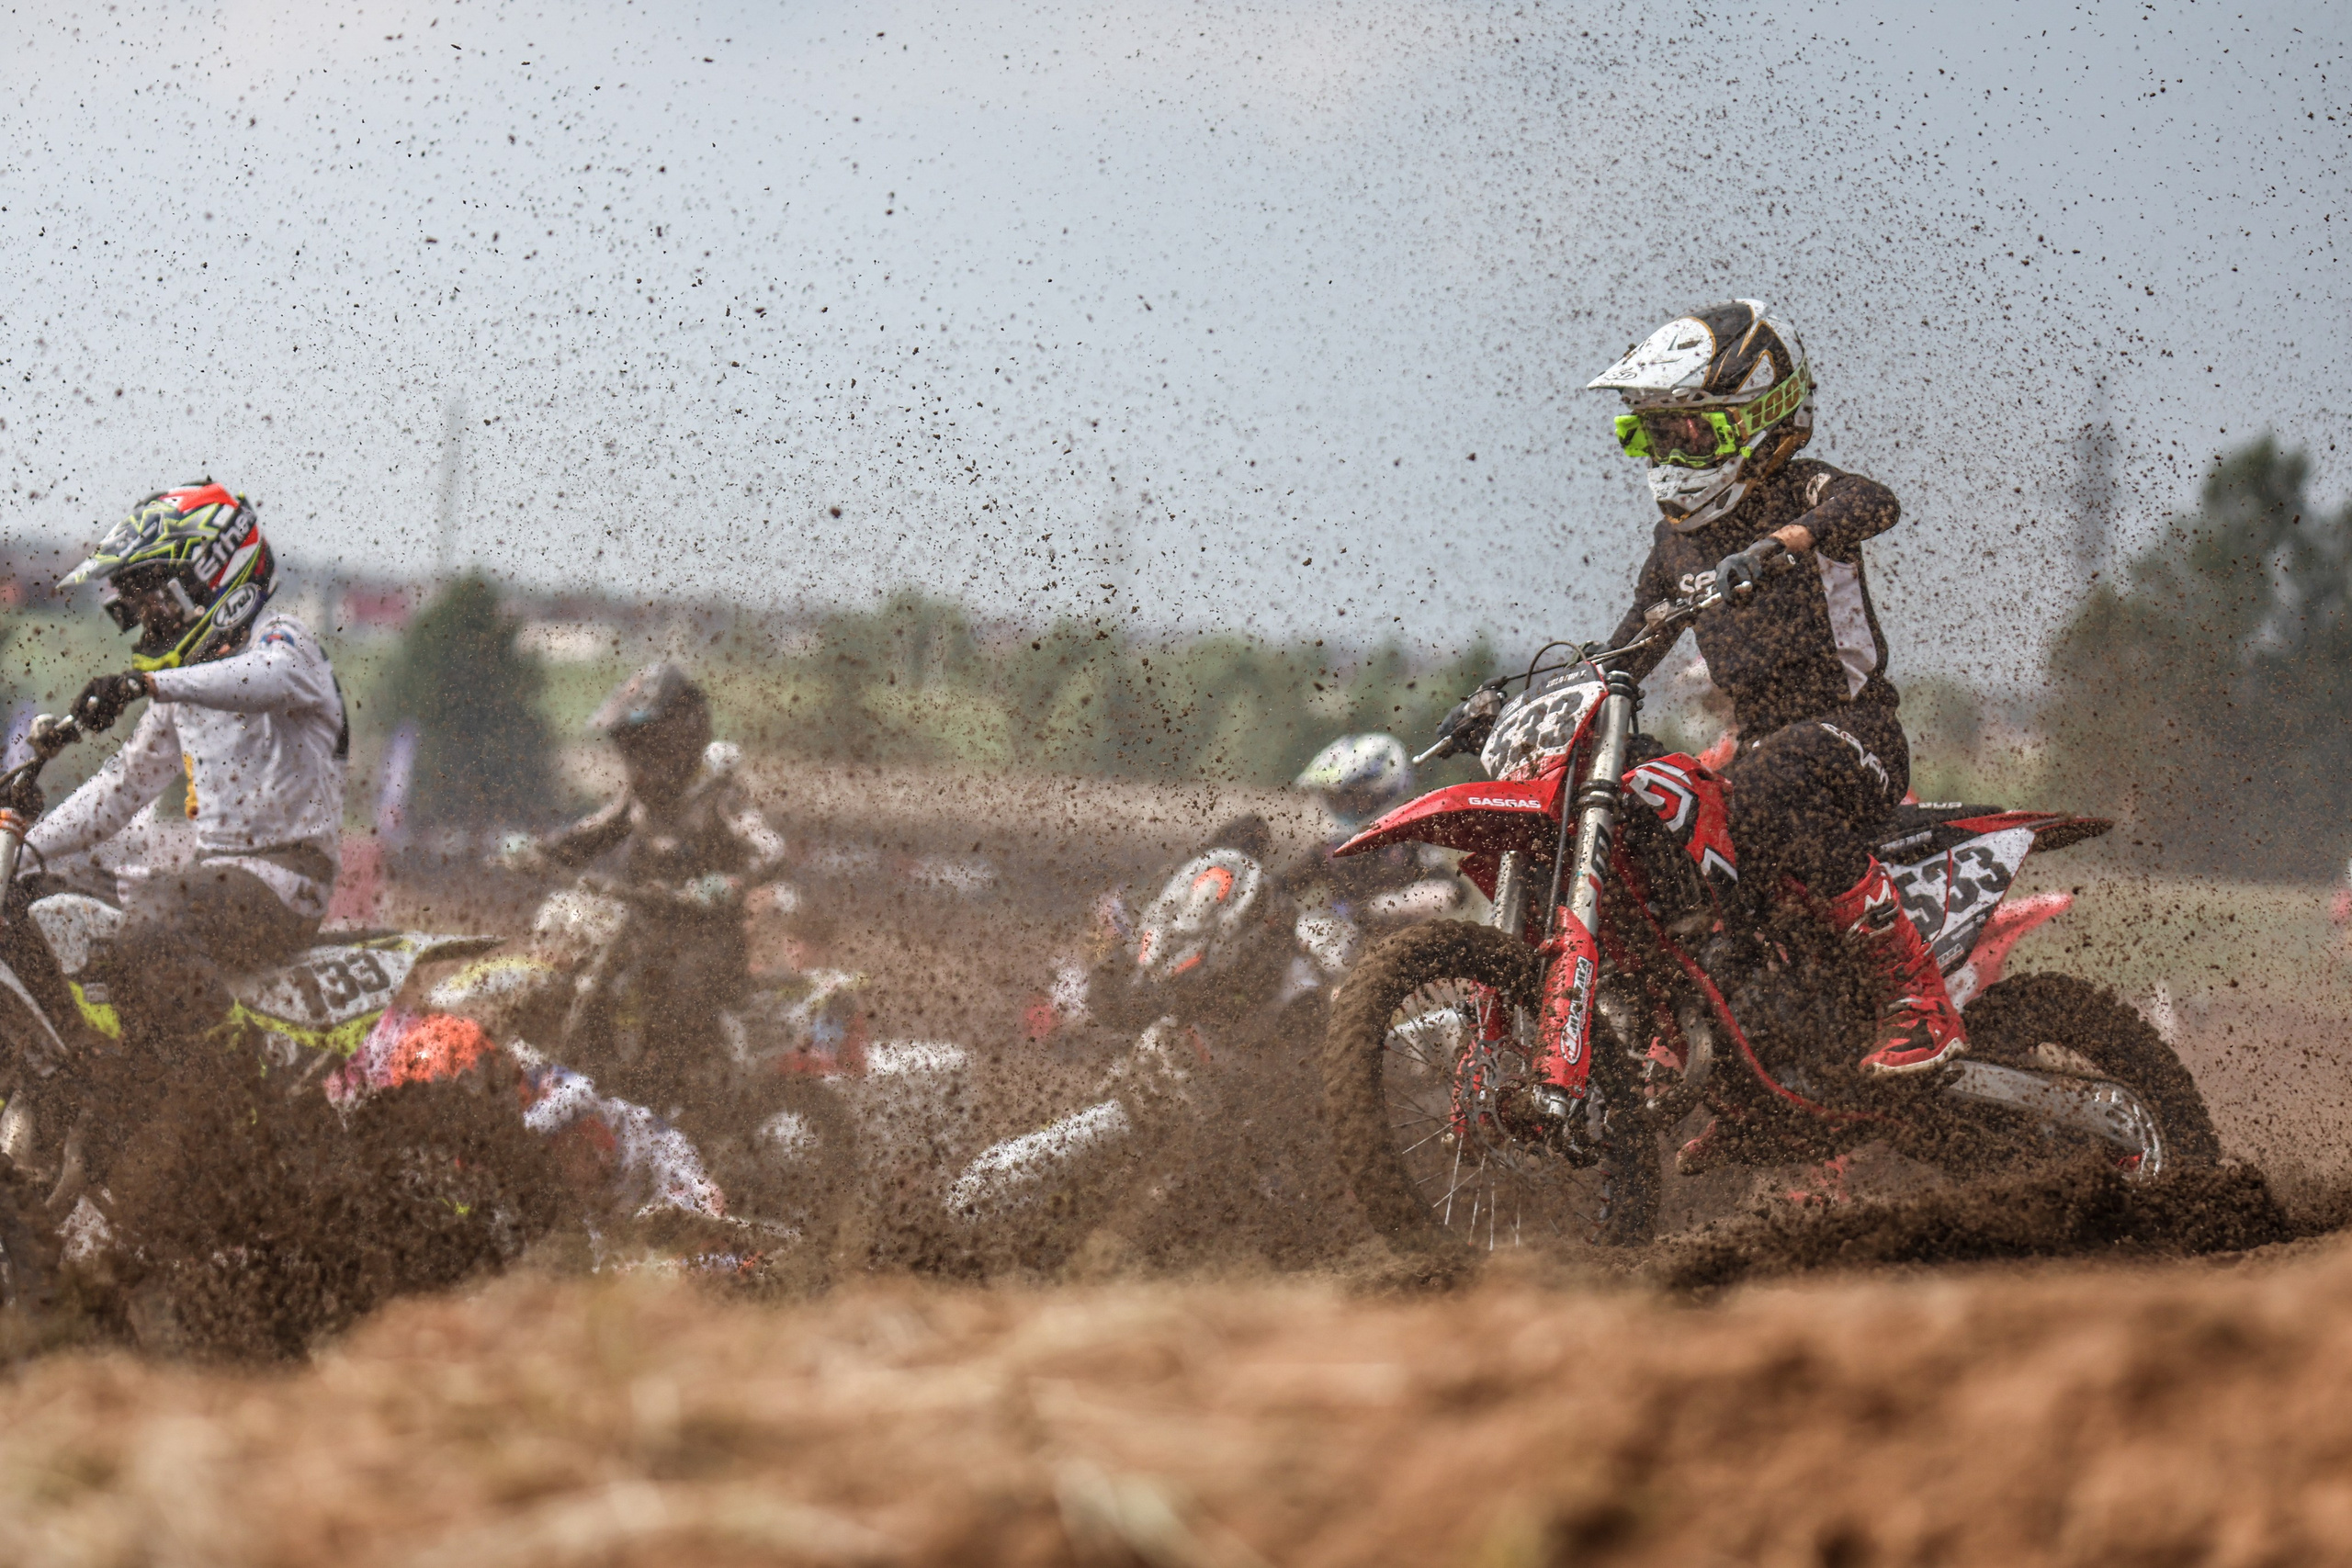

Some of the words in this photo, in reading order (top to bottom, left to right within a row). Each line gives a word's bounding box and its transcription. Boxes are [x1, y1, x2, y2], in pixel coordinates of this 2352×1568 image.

[1488, 691, 1584, 777] 533
[1468, 796, 1542, 809] GASGAS
[1894, 846, 2012, 939] 533
[292, 953, 391, 1020] 133
